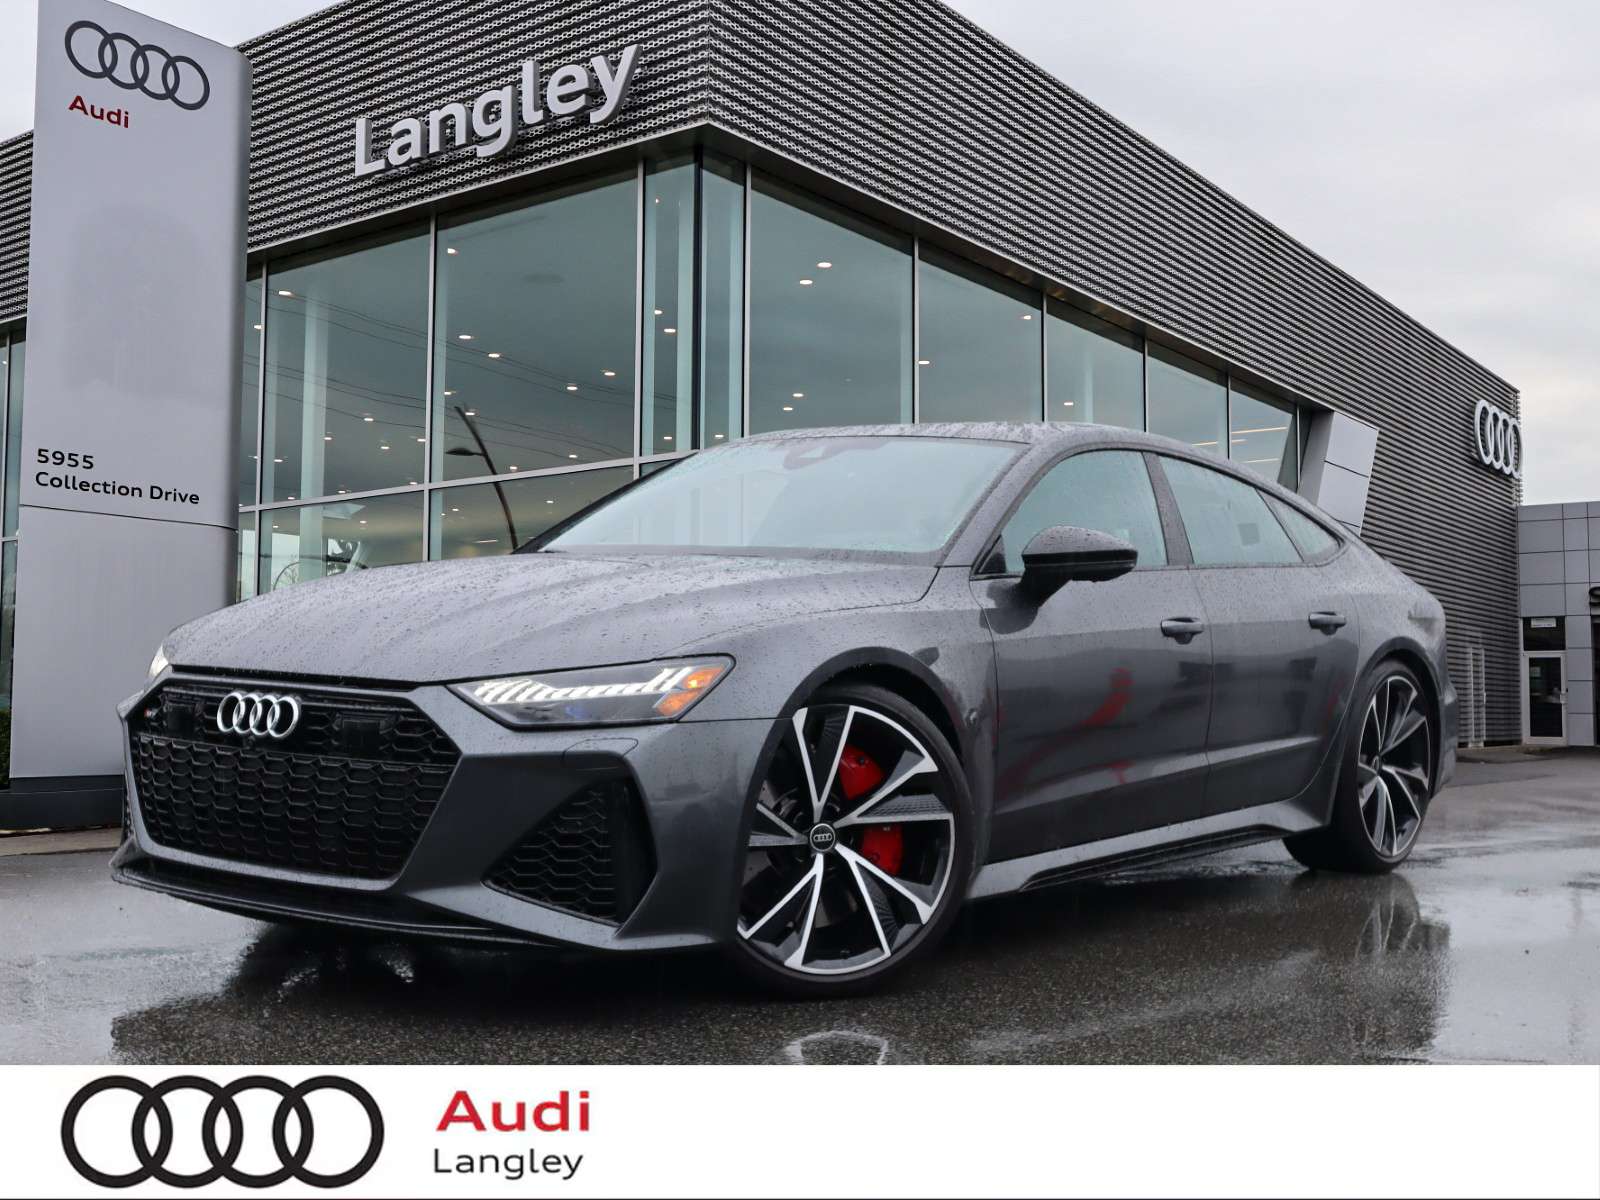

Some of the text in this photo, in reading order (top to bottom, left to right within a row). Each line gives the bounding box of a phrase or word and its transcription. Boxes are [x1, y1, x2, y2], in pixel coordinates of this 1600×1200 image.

[68, 95, 129, 129] Audi
[354, 44, 642, 176] Langley
[37, 448, 94, 469] 5955
[35, 471, 200, 504] Collection Drive
